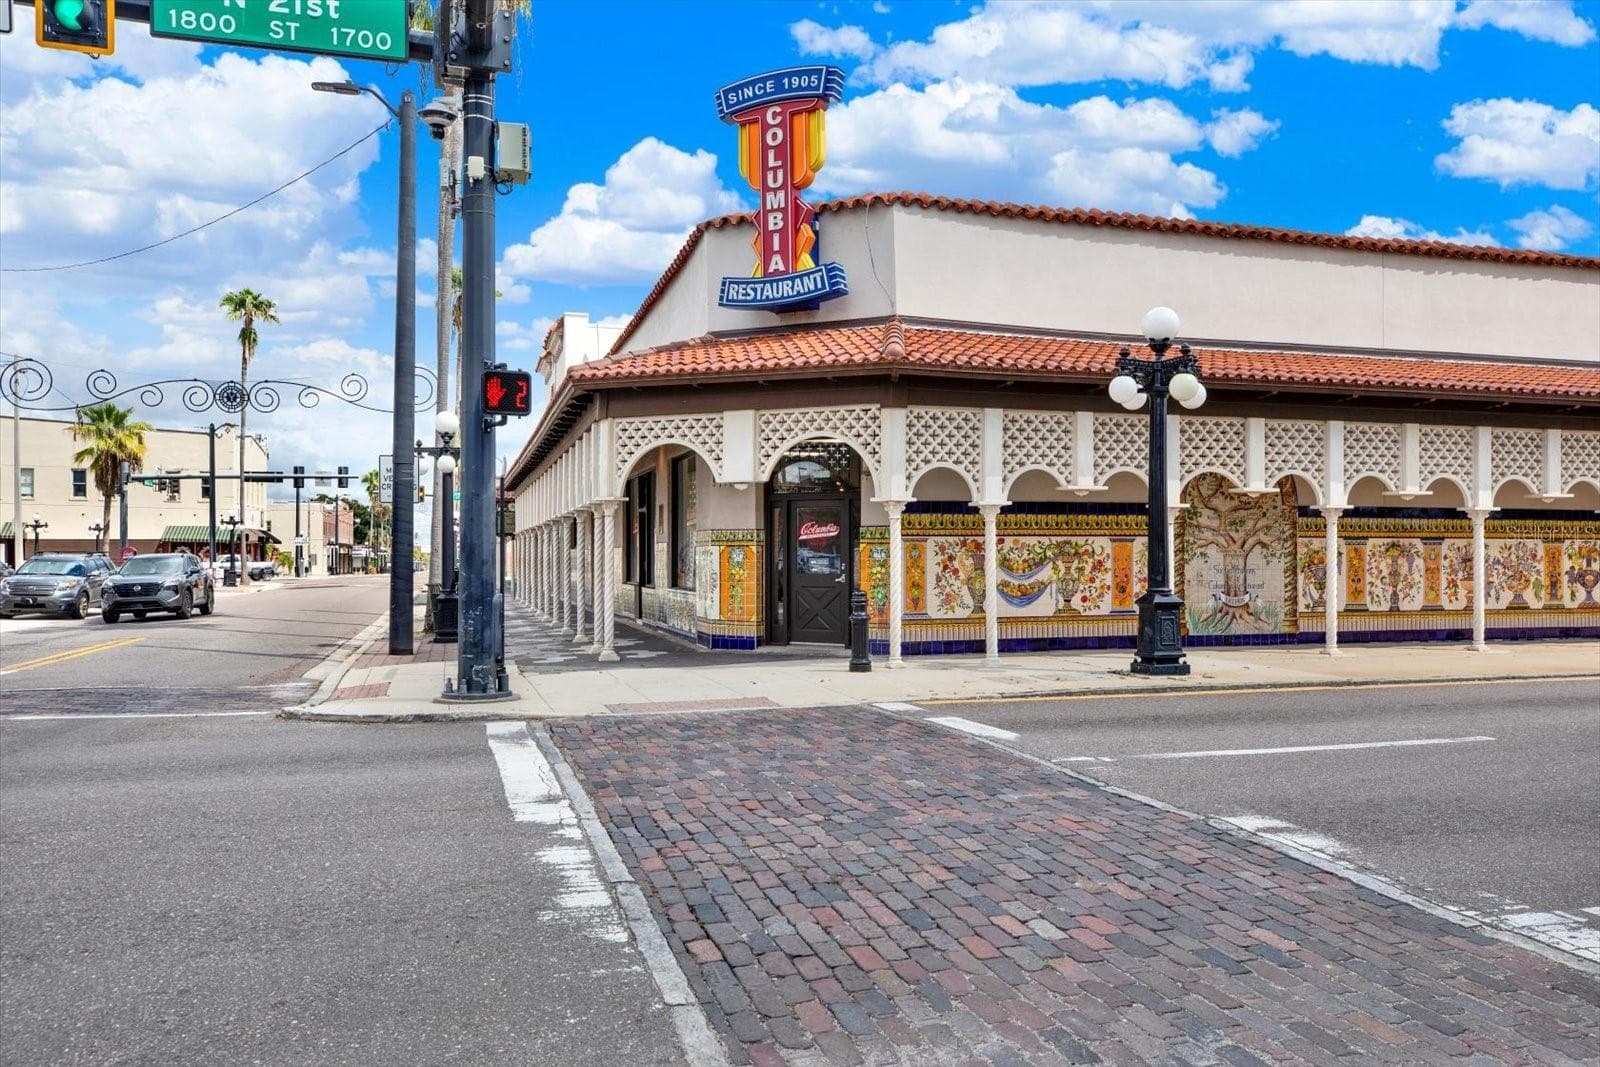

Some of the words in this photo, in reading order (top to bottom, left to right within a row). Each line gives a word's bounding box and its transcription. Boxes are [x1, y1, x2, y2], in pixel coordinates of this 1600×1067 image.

[268, 0, 340, 19] 21st
[169, 9, 236, 34] 1800
[268, 20, 300, 41] ST
[331, 27, 392, 51] 1700
[727, 80, 776, 105] SINCE
[782, 74, 819, 91] 1905
[765, 105, 786, 273] COLUMBIA
[727, 271, 824, 301] RESTAURANT
[514, 380, 528, 408] 2
[800, 520, 840, 537] Columbia
